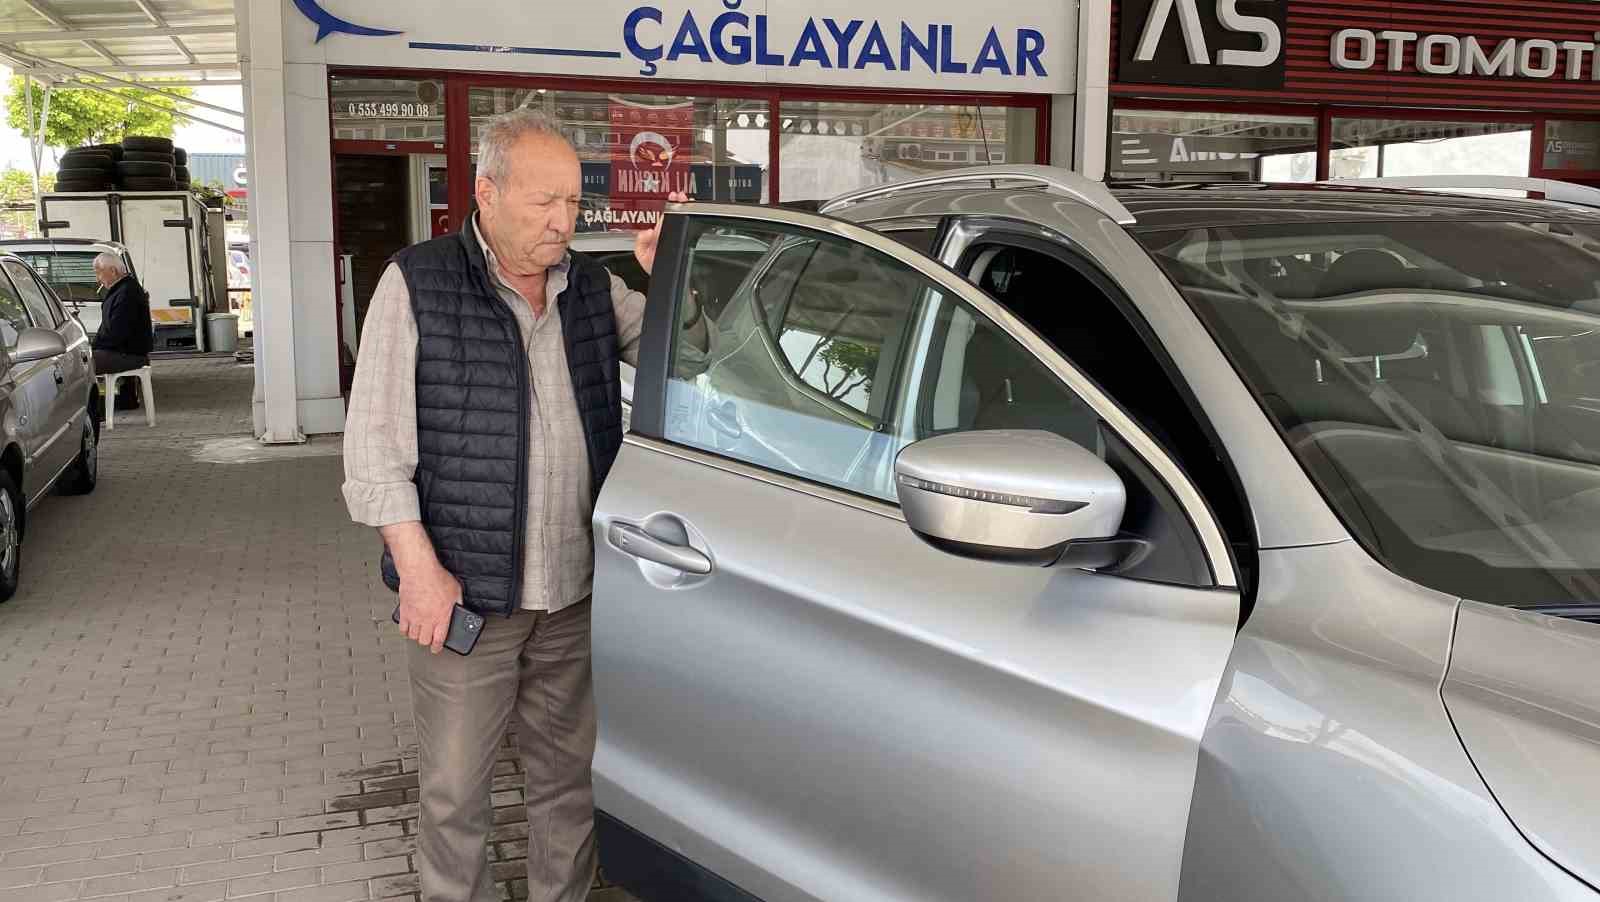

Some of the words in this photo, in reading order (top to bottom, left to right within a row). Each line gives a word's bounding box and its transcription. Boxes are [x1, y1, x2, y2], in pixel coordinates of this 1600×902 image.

[623, 0, 1048, 76] ÇAĞLAYANLAR
[1132, 0, 1281, 67] AS
[379, 103, 399, 117] 499
[401, 103, 414, 117] 90
[416, 103, 429, 118] 08
